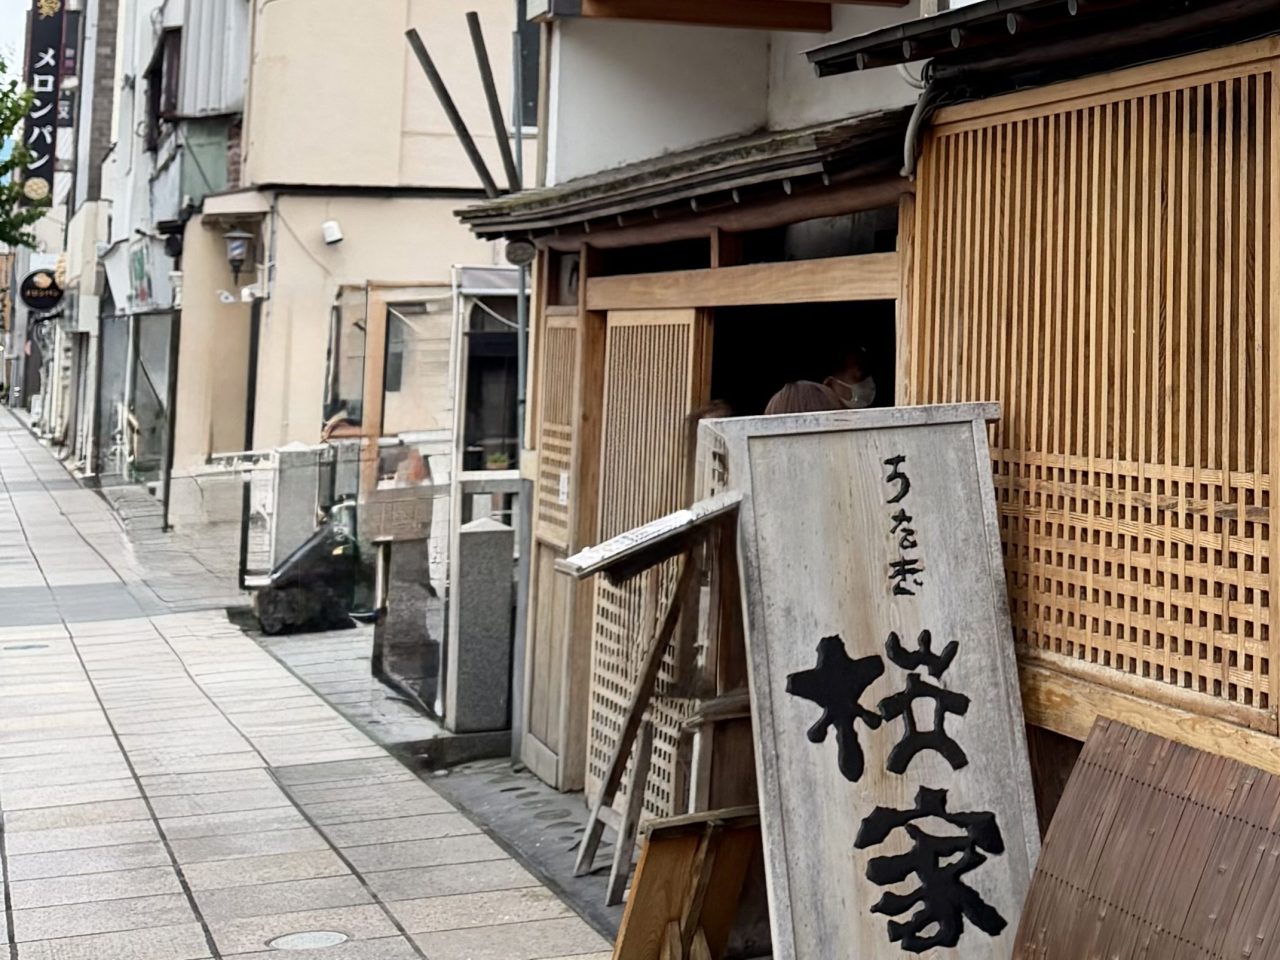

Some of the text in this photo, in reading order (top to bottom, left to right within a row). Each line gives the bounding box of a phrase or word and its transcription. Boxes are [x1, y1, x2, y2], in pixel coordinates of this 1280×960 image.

[27, 46, 56, 171] メロンパン
[785, 455, 1008, 954] うなぎ 桜家
